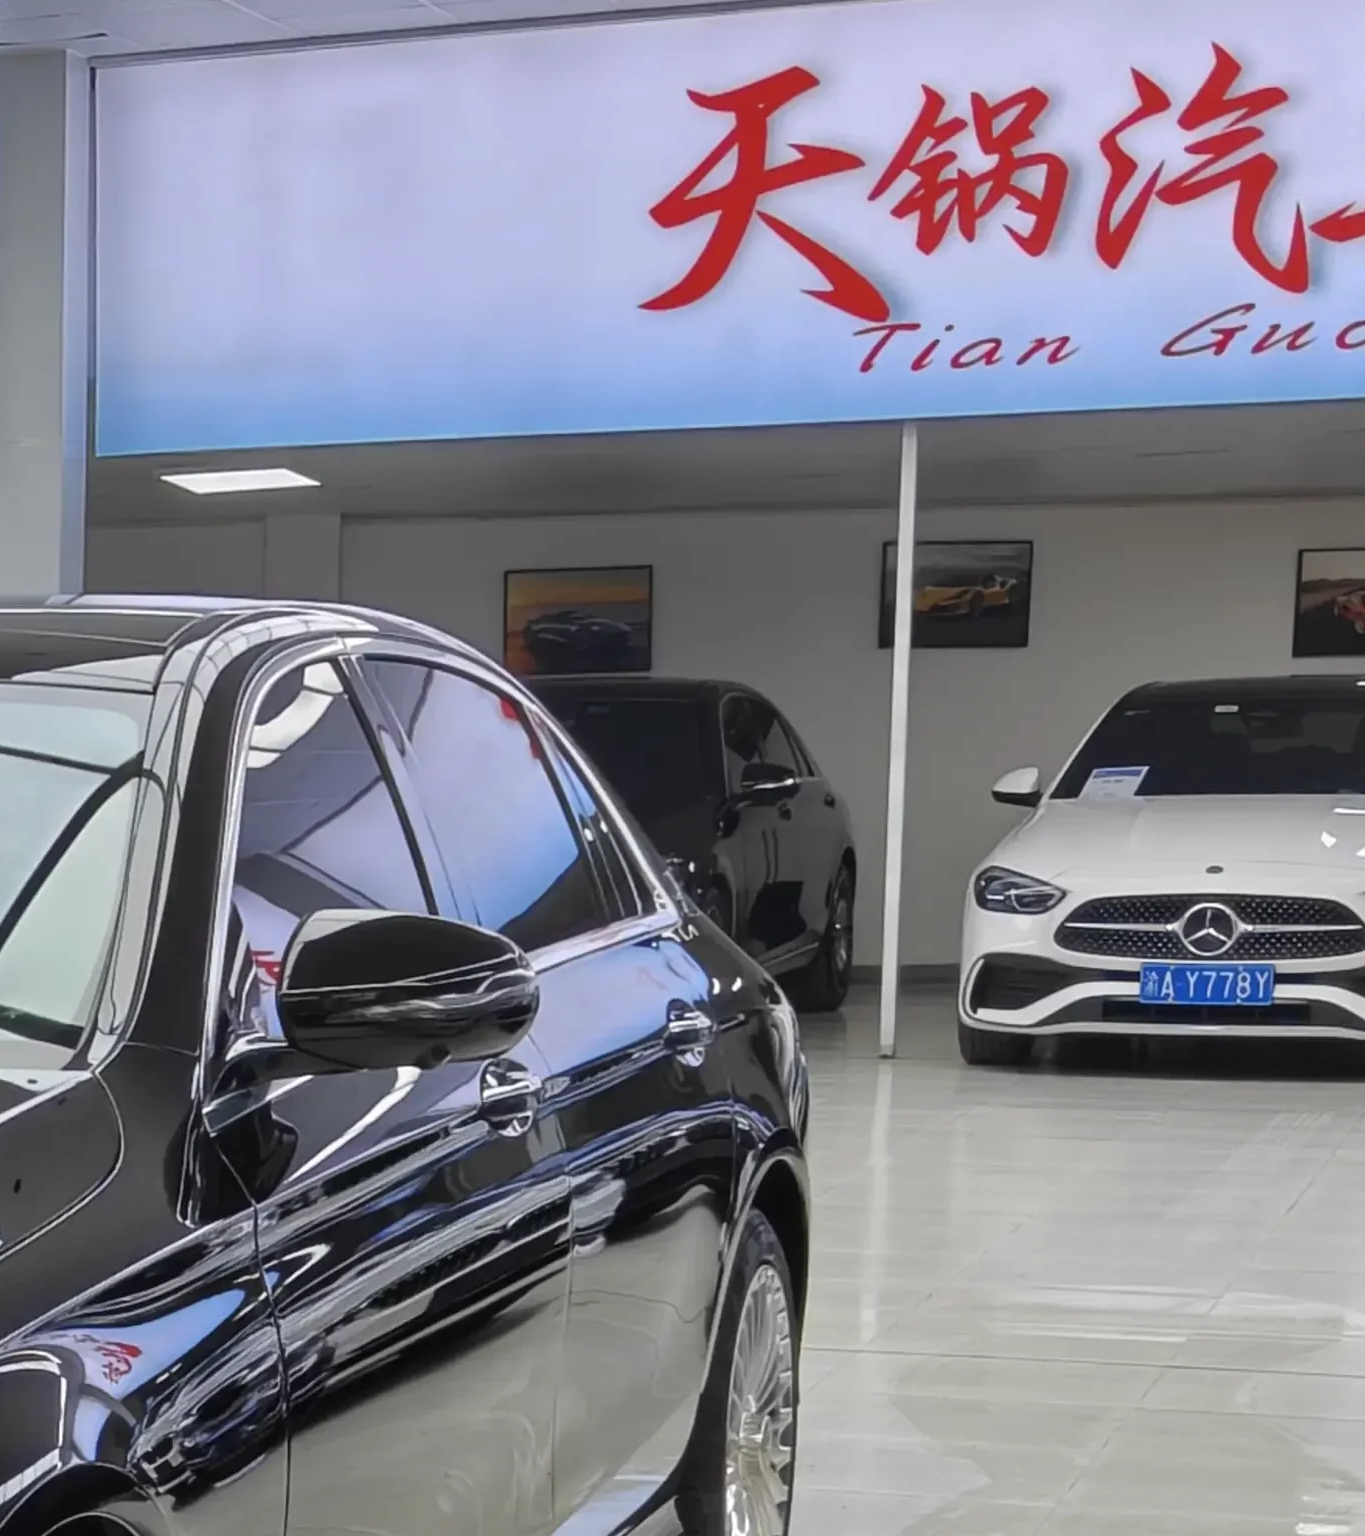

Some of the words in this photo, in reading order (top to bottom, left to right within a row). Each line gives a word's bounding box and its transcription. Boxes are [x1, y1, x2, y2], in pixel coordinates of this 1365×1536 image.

[637, 42, 1365, 323] 天锅汽
[853, 322, 1081, 373] Tian
